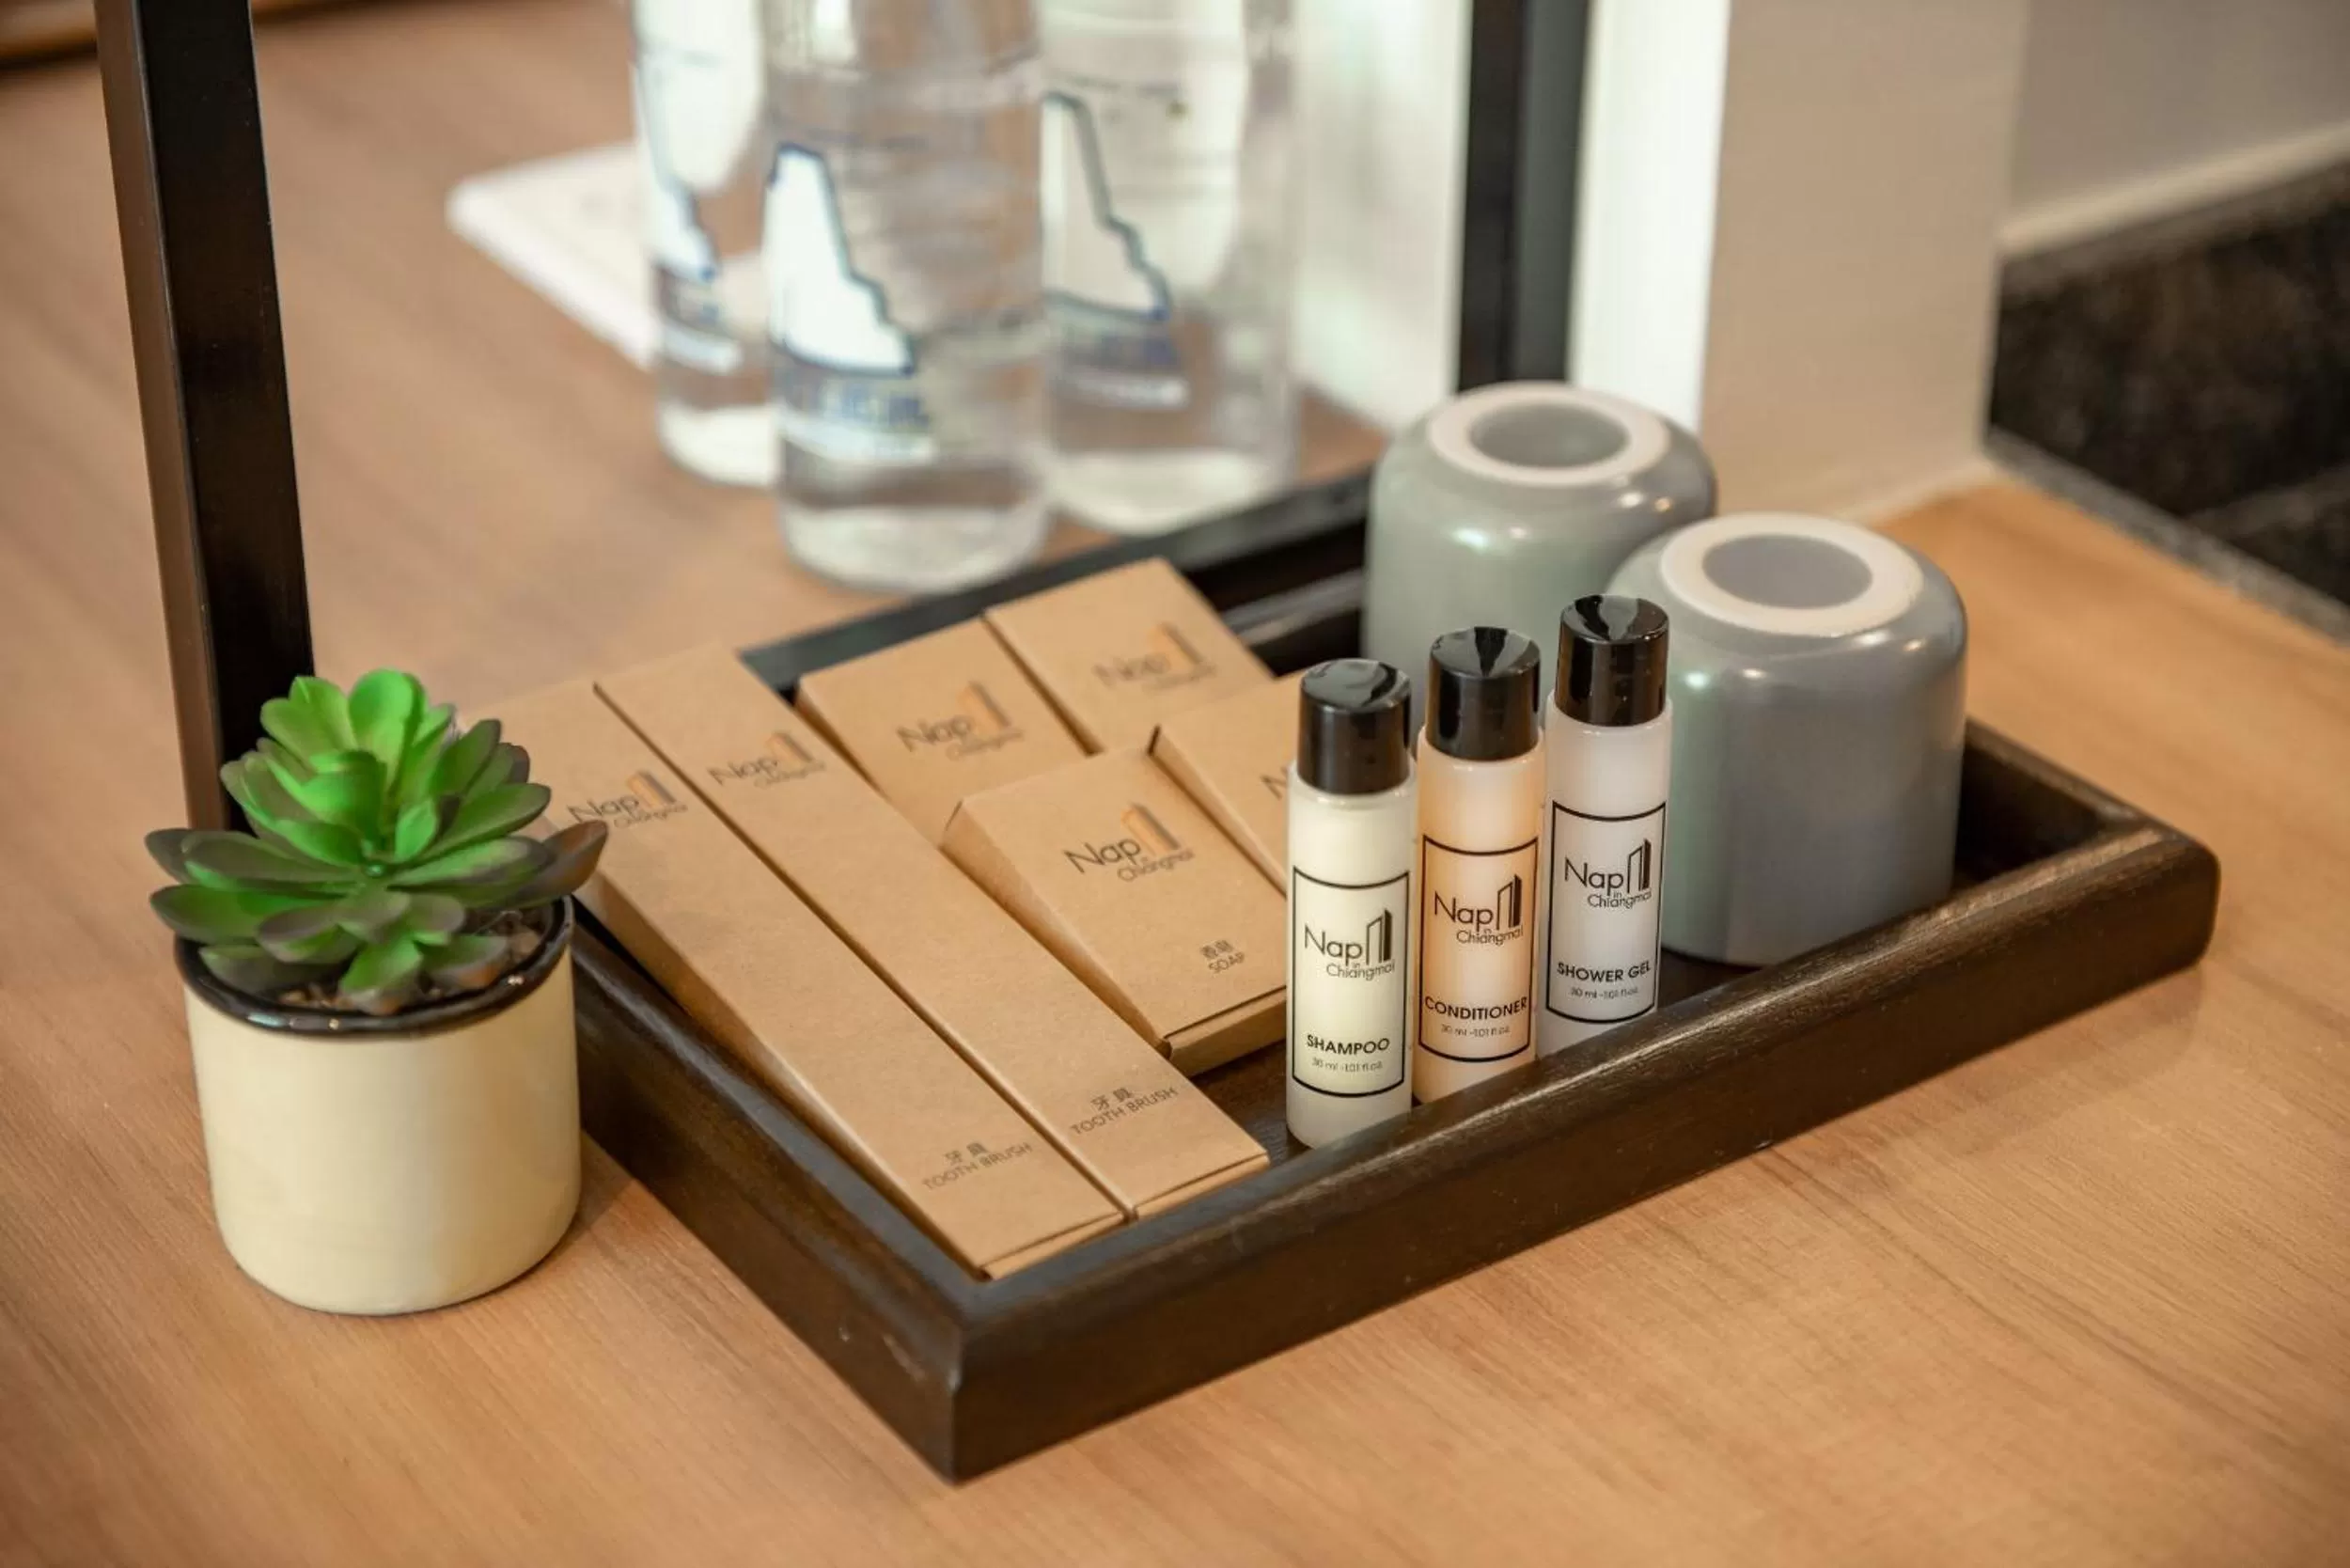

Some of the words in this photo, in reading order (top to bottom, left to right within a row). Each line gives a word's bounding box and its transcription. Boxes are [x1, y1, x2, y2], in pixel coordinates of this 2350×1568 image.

[897, 714, 972, 752] Nap
[707, 756, 779, 786] Nap
[566, 796, 640, 824] Nap
[1063, 838, 1141, 874] Nap
[1564, 855, 1623, 896] Nap
[1434, 891, 1494, 932] Nap
[1305, 924, 1363, 966] Nap
[1557, 962, 1623, 982] SHOWER
[1628, 960, 1651, 980] GEL
[1424, 996, 1528, 1020] CONDITIONER
[1307, 1034, 1390, 1055] SHAMPOO
[1070, 1106, 1126, 1135] TOOTH
[1126, 1087, 1179, 1112] BRUSH
[922, 1163, 978, 1190] TOOTH
